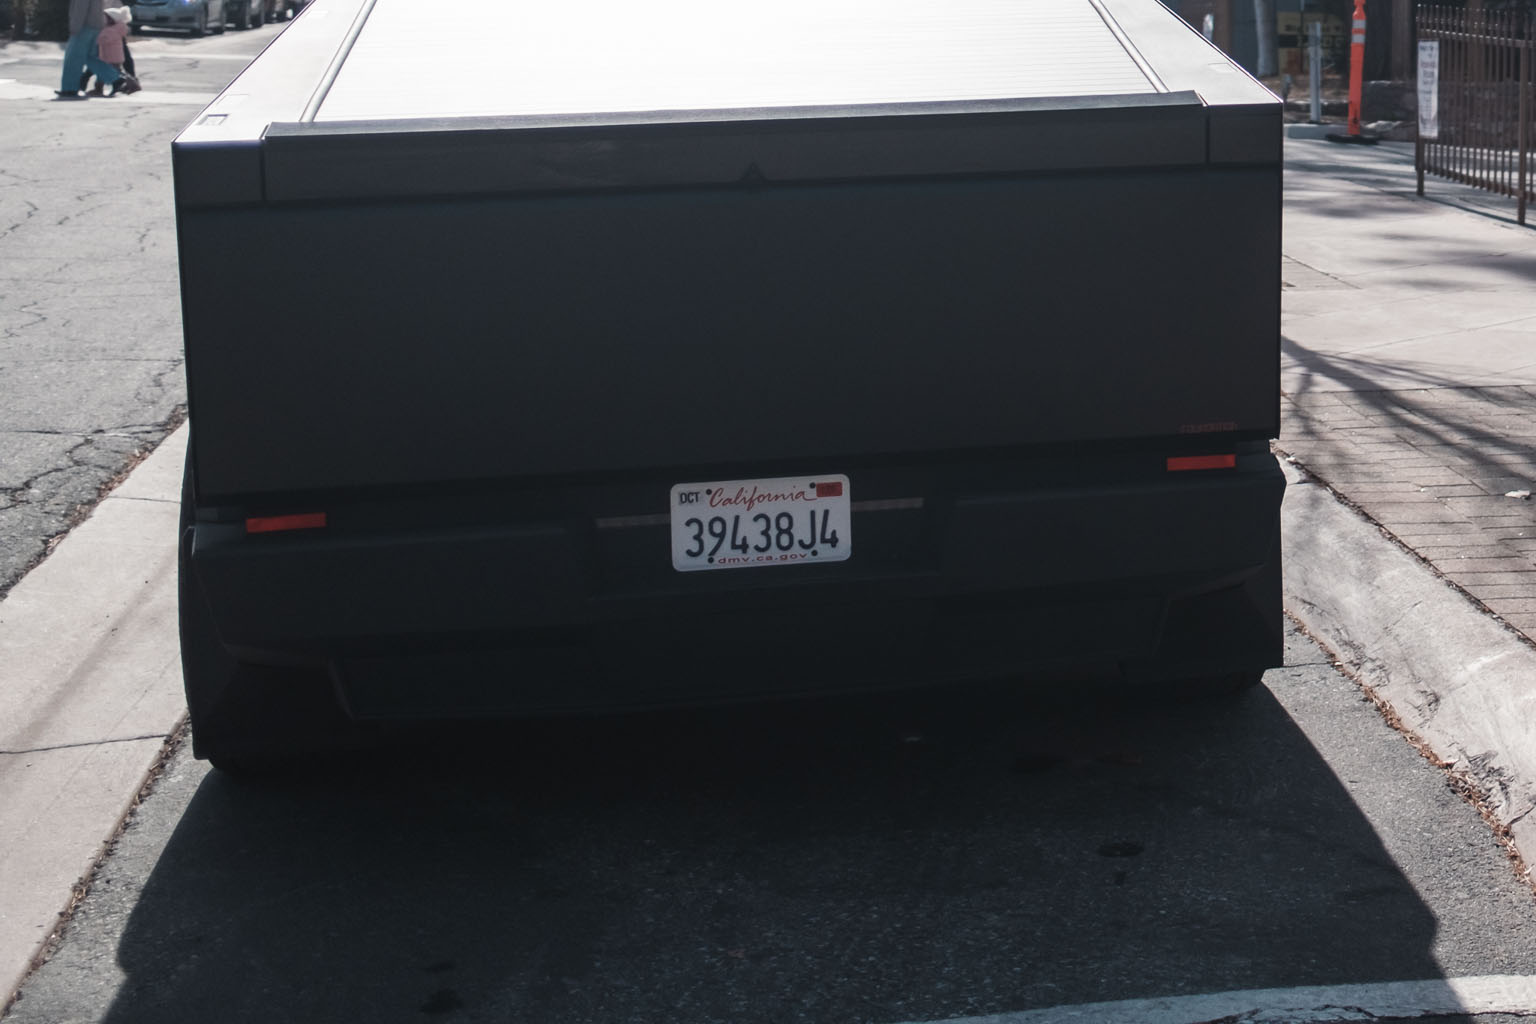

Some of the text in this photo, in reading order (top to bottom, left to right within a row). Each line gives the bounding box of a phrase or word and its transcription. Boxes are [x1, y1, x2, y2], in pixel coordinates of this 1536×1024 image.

[680, 491, 700, 505] OCT
[709, 485, 817, 511] California
[685, 509, 839, 558] 39438J4
[718, 553, 807, 564] dmv.ca.gov
